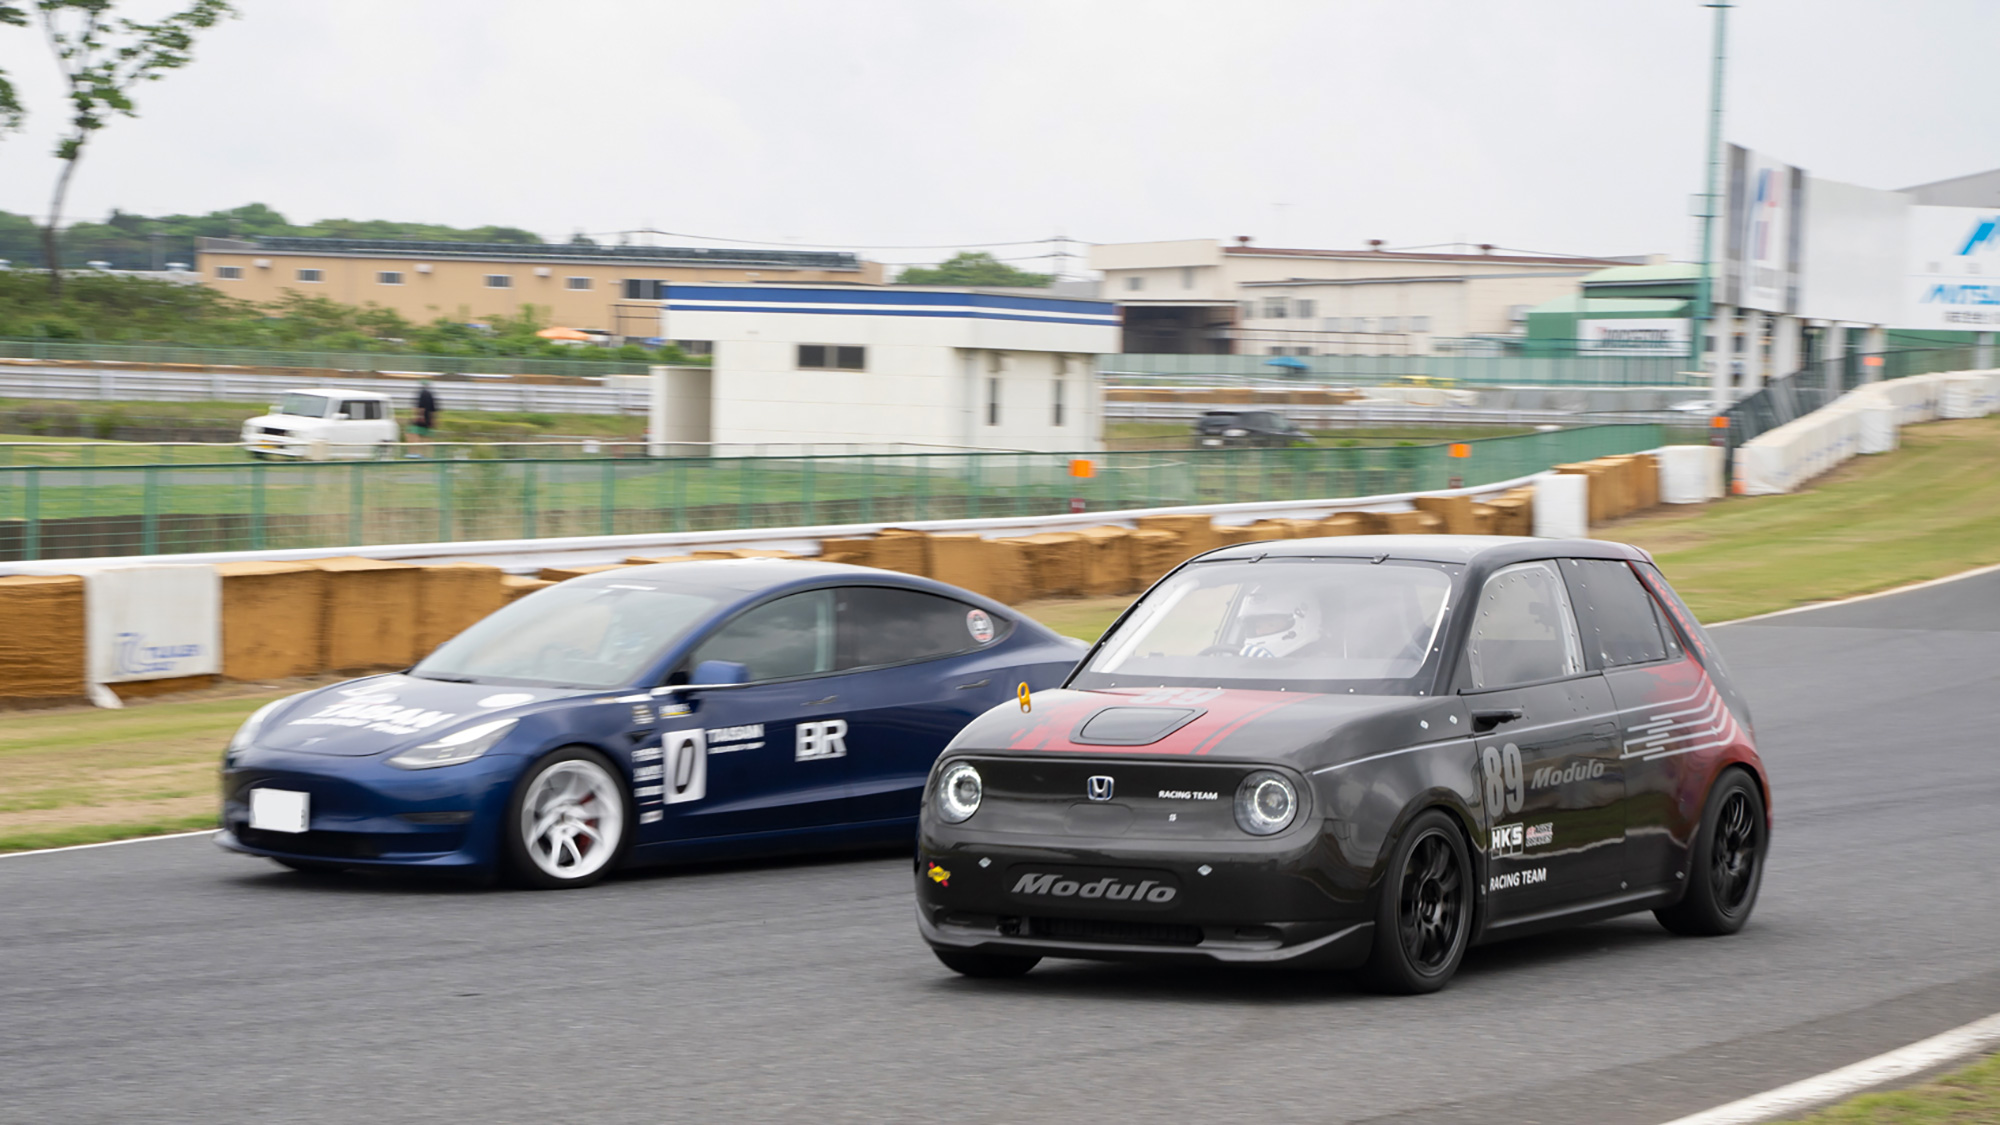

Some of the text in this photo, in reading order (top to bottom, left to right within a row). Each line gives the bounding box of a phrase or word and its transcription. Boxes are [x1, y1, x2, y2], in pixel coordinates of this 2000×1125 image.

[795, 719, 848, 760] BR
[675, 738, 695, 795] 0
[1483, 743, 1525, 817] 89
[1531, 758, 1605, 789] Modulo
[1158, 790, 1218, 800] RACING TEAM
[1491, 824, 1523, 851] HKS
[1011, 873, 1177, 903] Modulo
[1490, 867, 1547, 892] RACING TEAM
